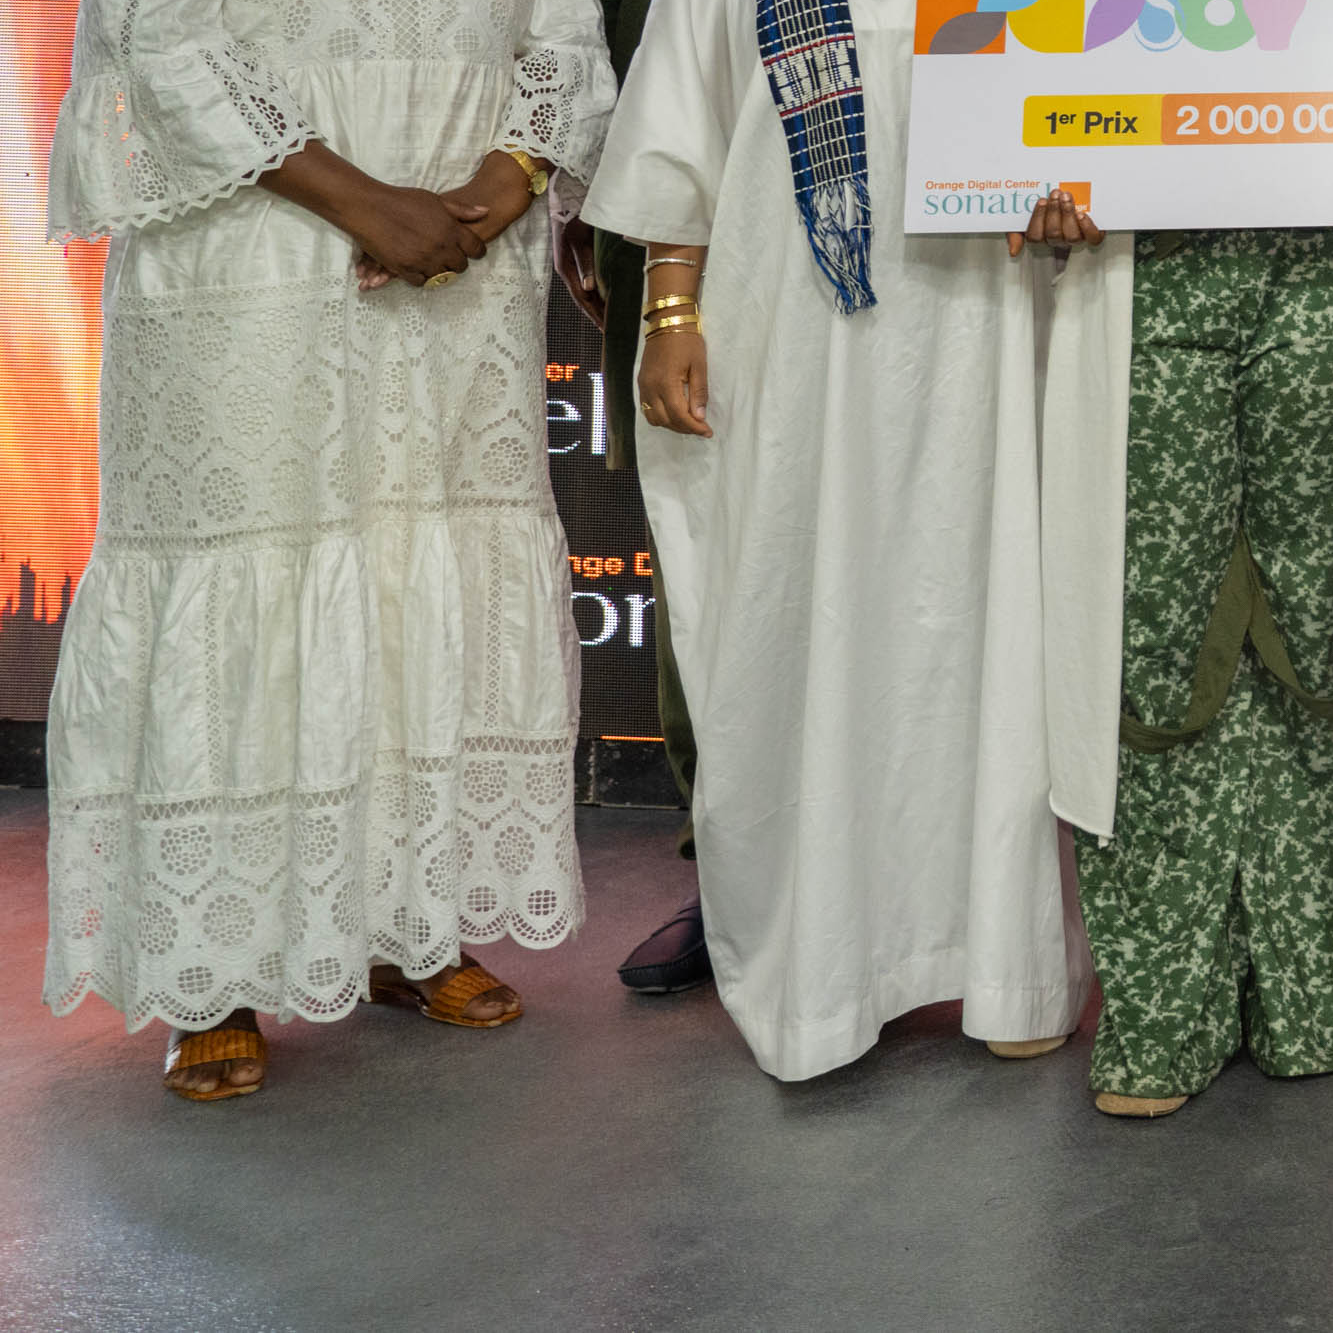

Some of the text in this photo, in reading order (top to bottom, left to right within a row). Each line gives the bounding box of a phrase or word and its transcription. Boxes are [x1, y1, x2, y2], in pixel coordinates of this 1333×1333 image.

[1045, 111, 1076, 135] 1er
[1084, 111, 1138, 134] Prix
[926, 179, 1040, 192] Orange Digital Center
